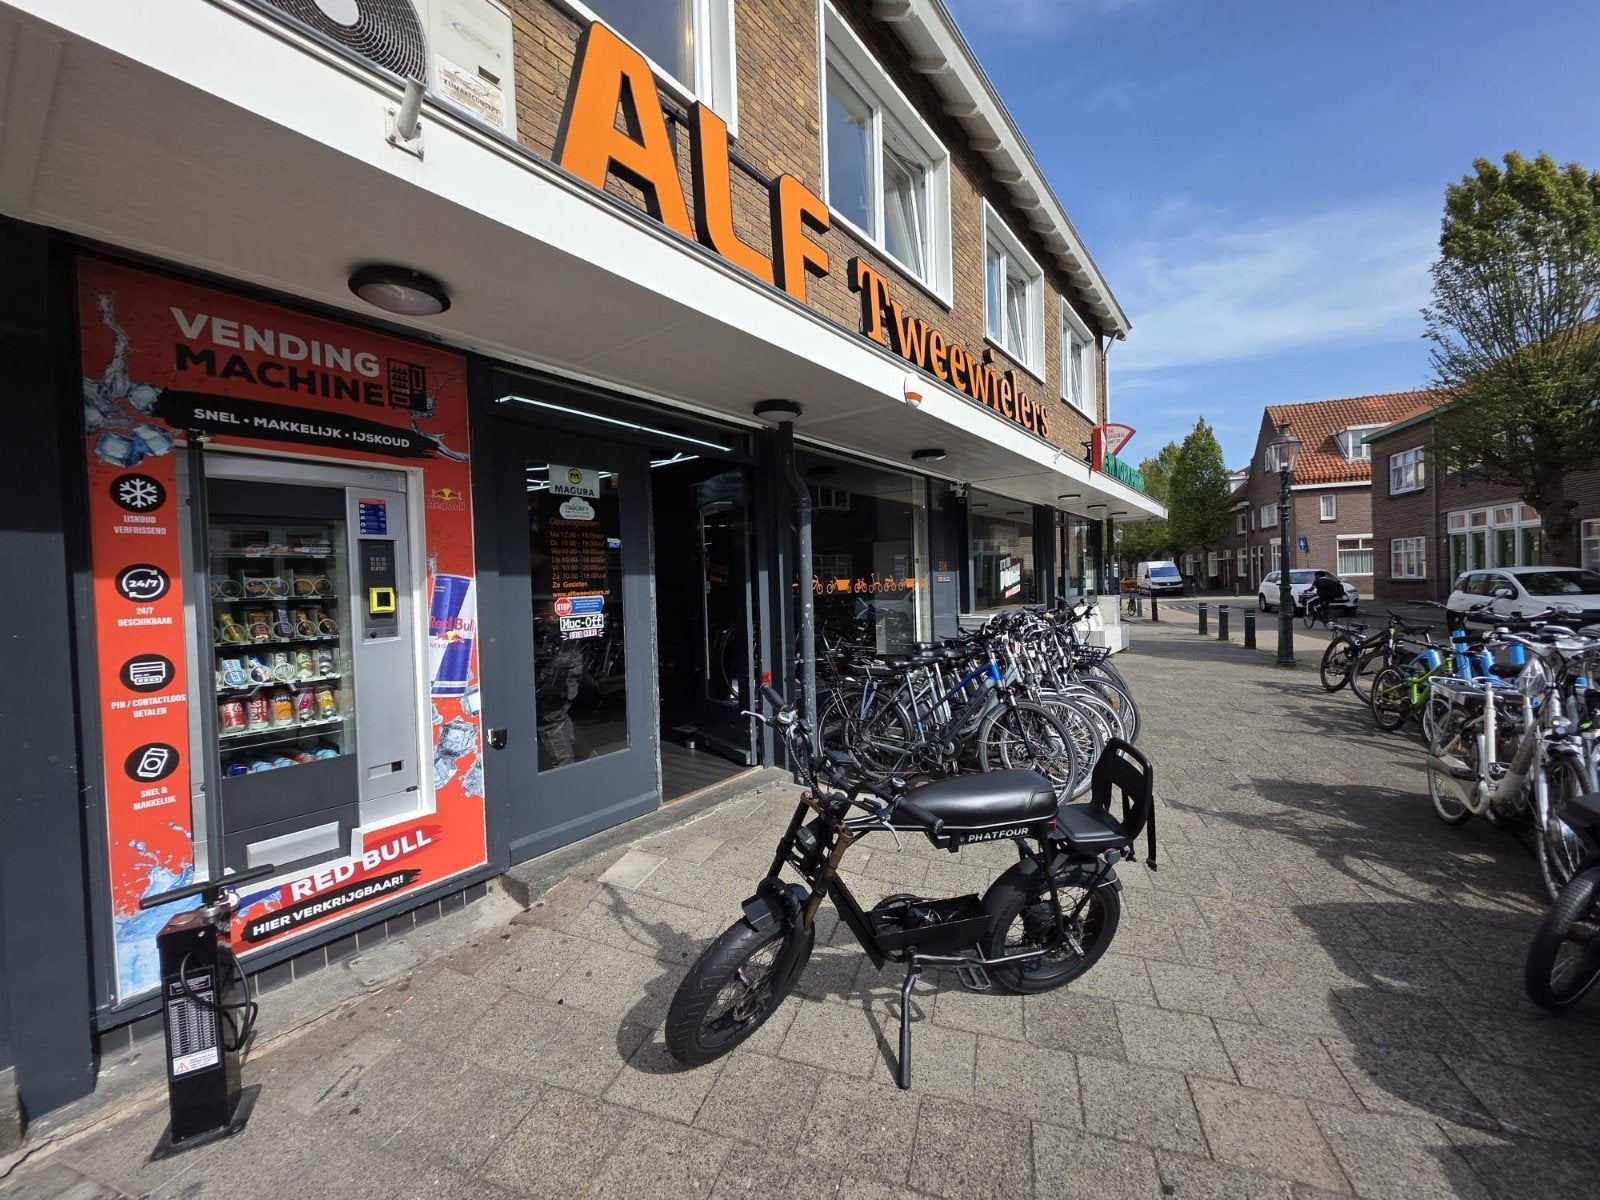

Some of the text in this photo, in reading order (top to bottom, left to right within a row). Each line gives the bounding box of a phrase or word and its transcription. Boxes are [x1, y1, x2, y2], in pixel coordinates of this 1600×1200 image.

[556, 21, 1050, 439] ALF Tweewielers
[170, 306, 380, 377] VENDING
[175, 343, 384, 407] MACHINE
[194, 408, 410, 448] SNEL MAKKELIJK IJSKOUD
[554, 485, 595, 497] MAGURA
[123, 515, 156, 524] IJSKOUD
[113, 526, 167, 536] VERFRISSEND
[128, 578, 158, 588] 24/7
[135, 606, 154, 615] 24/7
[556, 602, 570, 612] STOP
[117, 617, 173, 627] BESCHIKBAAR
[430, 615, 475, 632] Red Bull
[561, 615, 602, 630] Muc-Off
[110, 701, 126, 710] PIN
[132, 694, 186, 707] CONTACTLOOS
[133, 707, 168, 719] BETALEN
[140, 786, 168, 798] SNEL &
[133, 795, 176, 811] MAKKELIJK
[968, 827, 1029, 843] PHATFOUR
[291, 829, 433, 902] RED BULL
[252, 874, 405, 937] HIER VERKRIJGBAAR!
